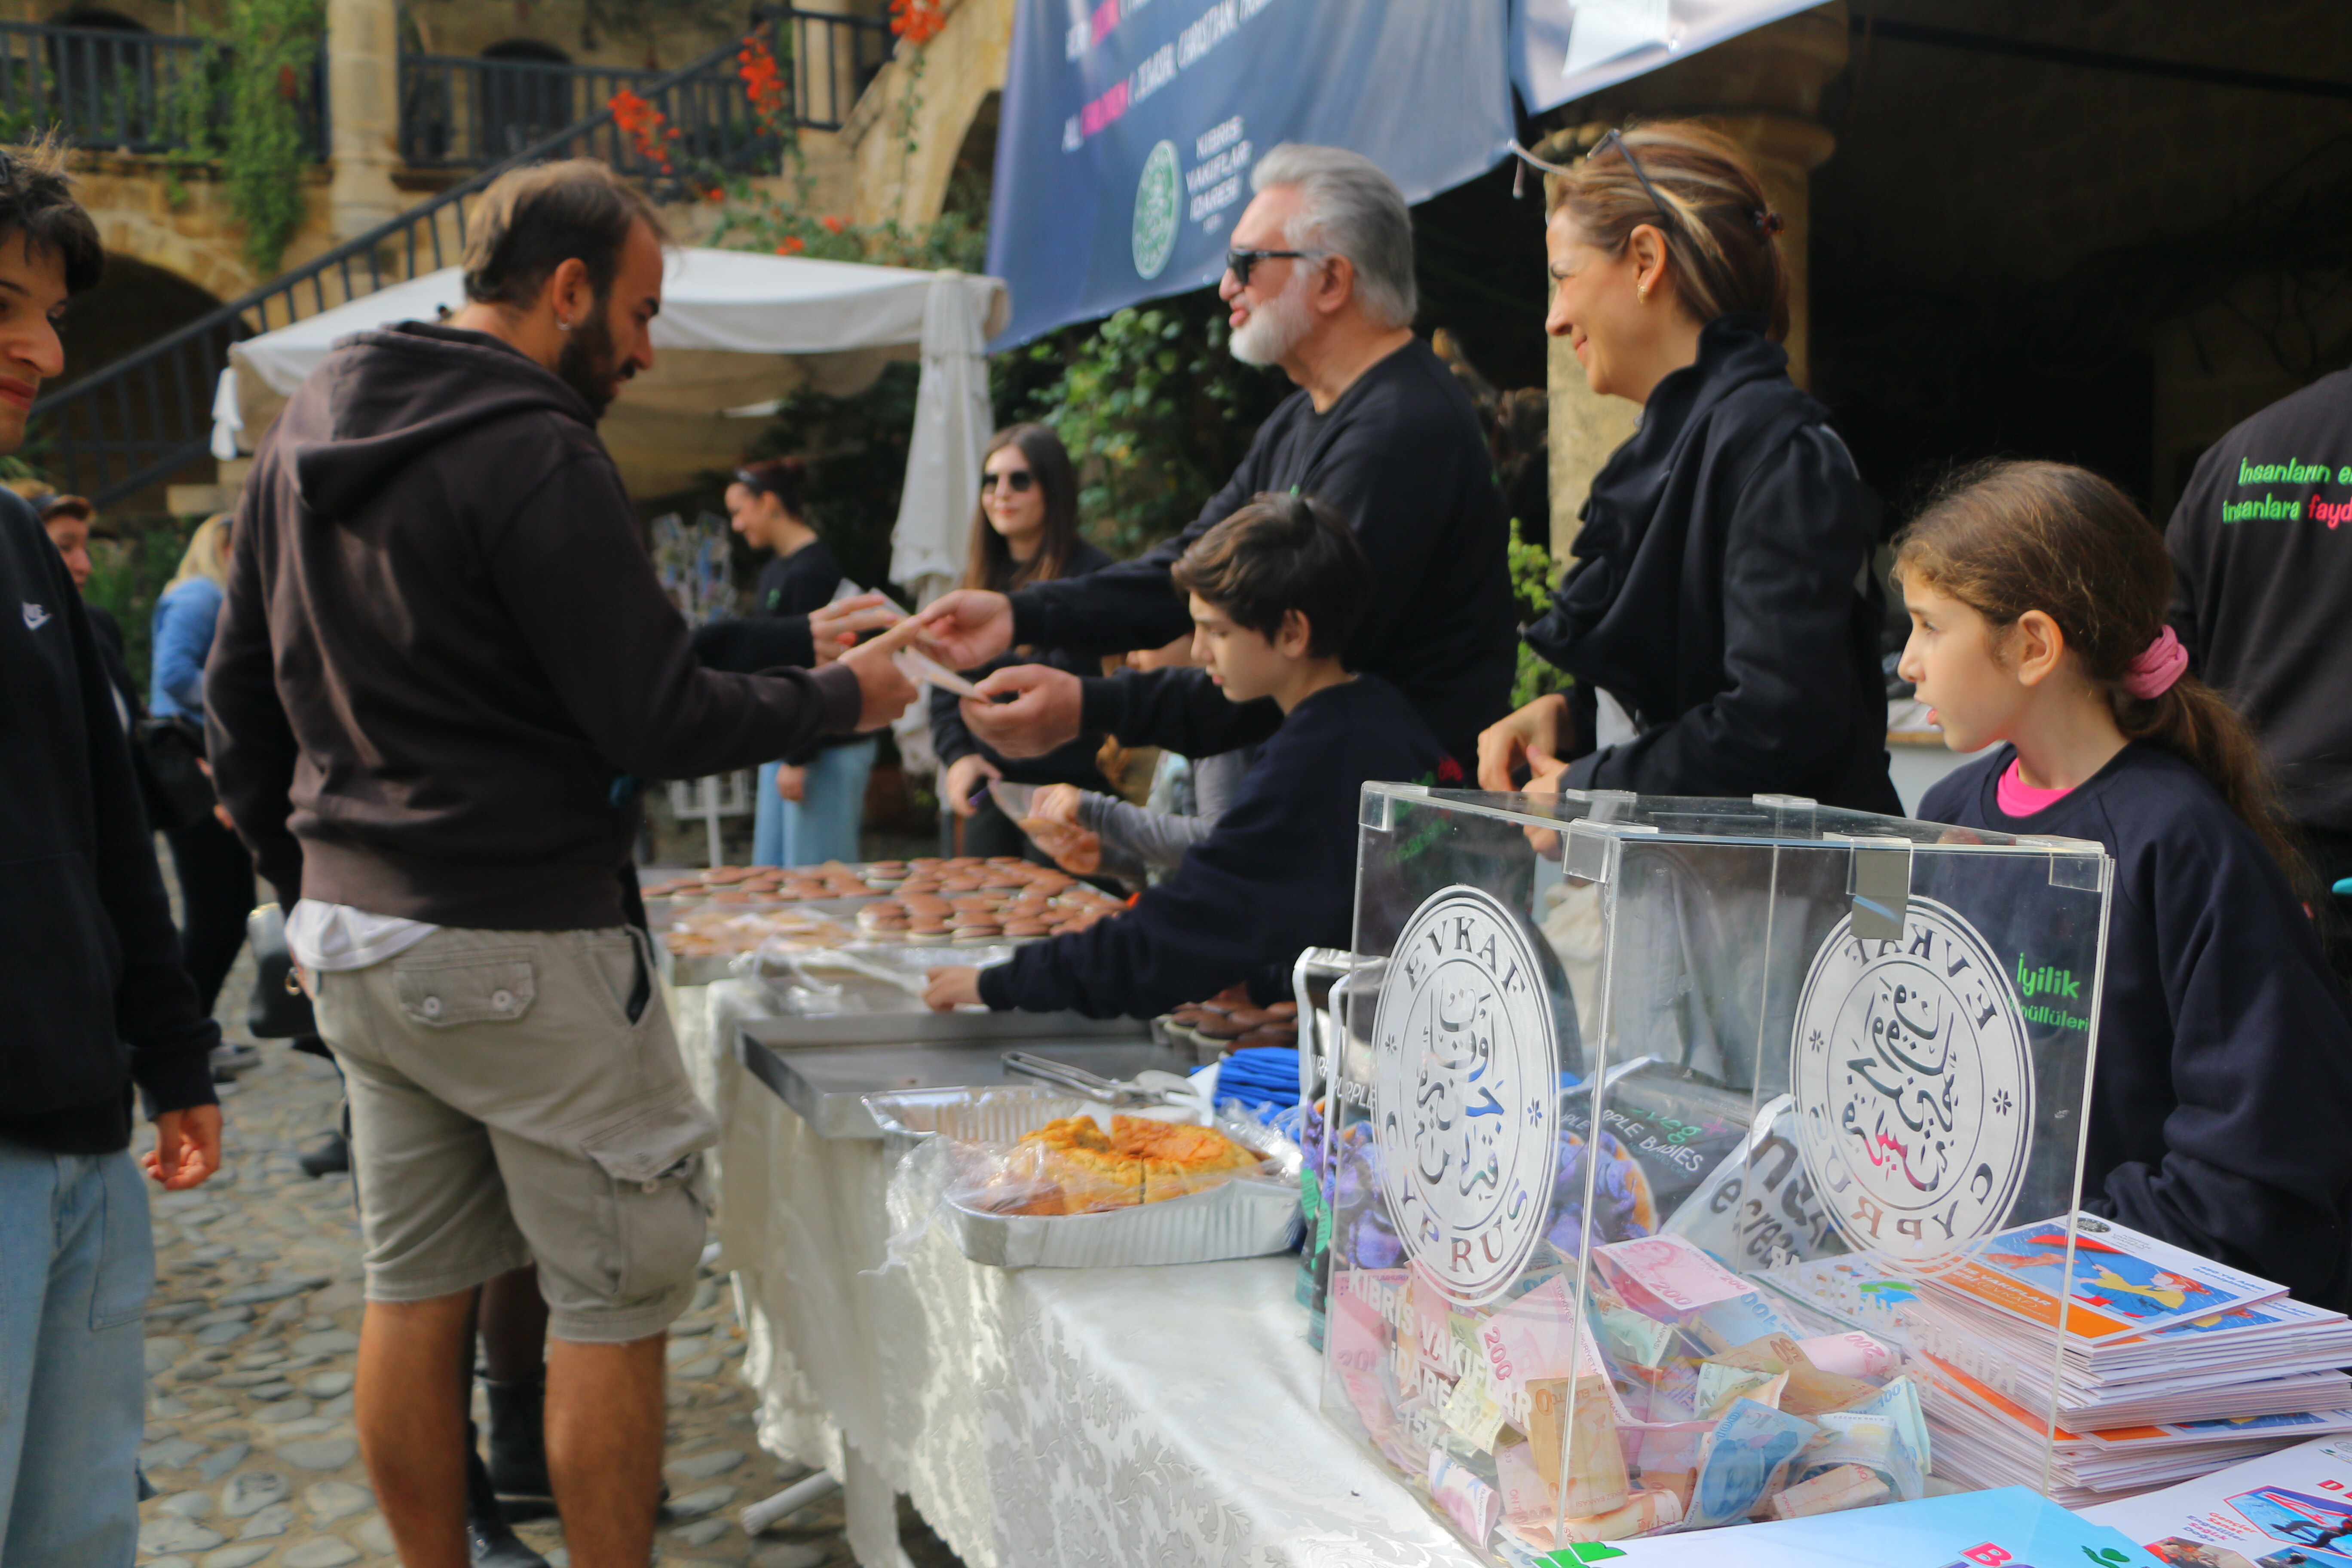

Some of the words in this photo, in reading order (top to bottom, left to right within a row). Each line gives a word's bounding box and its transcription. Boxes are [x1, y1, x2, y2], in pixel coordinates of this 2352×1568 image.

[1196, 115, 1243, 162] KIBRIS
[1186, 140, 1253, 196] VAKIFLAR
[2222, 493, 2301, 524] insanlara
[1404, 916, 1526, 998] EVKAF
[1639, 1135, 1704, 1172] BABIES
[1384, 1110, 1531, 1274] CYPRUS
[1649, 1280, 1692, 1305] 200
[1719, 1275, 1748, 1290] 200
[1977, 1281, 2038, 1308] (EVKAF)
[1980, 1274, 2052, 1306] VAKIFLAR
[1349, 1262, 1414, 1336] KIBRIS
[1556, 1284, 1572, 1317] TÜRKİYE
[1740, 1291, 1779, 1327] 100
[1484, 1326, 1513, 1381] 200
[1770, 1337, 1805, 1365] 50
[1843, 1334, 1886, 1359] 200
[1421, 1314, 1532, 1432] VAKIFLAR
[1877, 1383, 1901, 1407] 100
[1716, 1411, 1740, 1442] 100
[1477, 1488, 1486, 1525] BANKASI
[1575, 1492, 1605, 1507] BANKASI
[2182, 1526, 2216, 1542] Doğa
[2186, 1514, 2248, 1542] Engelliler
[2206, 1517, 2244, 1534] Sanat
[2208, 1512, 2258, 1534] Gençler
